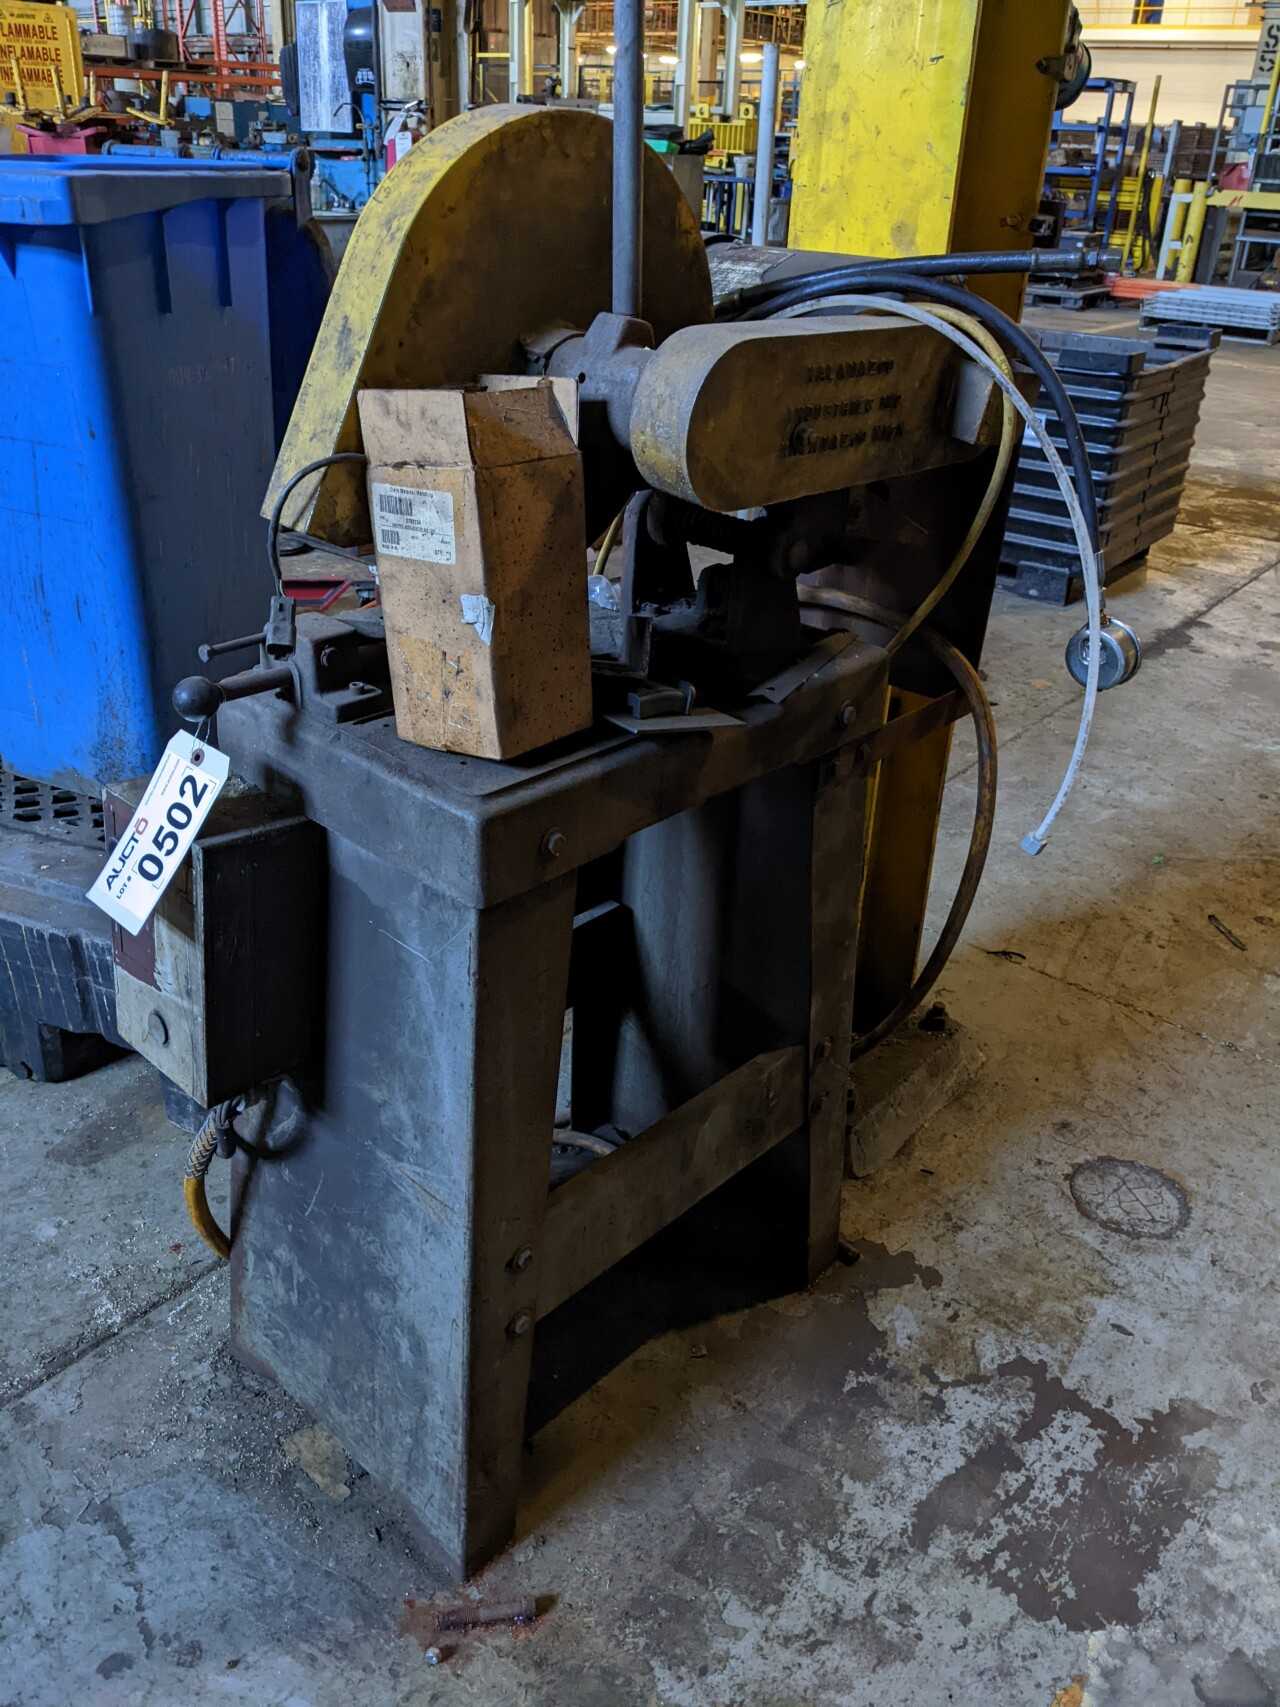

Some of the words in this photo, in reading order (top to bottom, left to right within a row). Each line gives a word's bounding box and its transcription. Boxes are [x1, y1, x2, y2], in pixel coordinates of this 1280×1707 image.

[0, 44, 61, 62] NFLAMABLE
[106, 817, 149, 891] AUCTO
[137, 774, 209, 883] 0502
